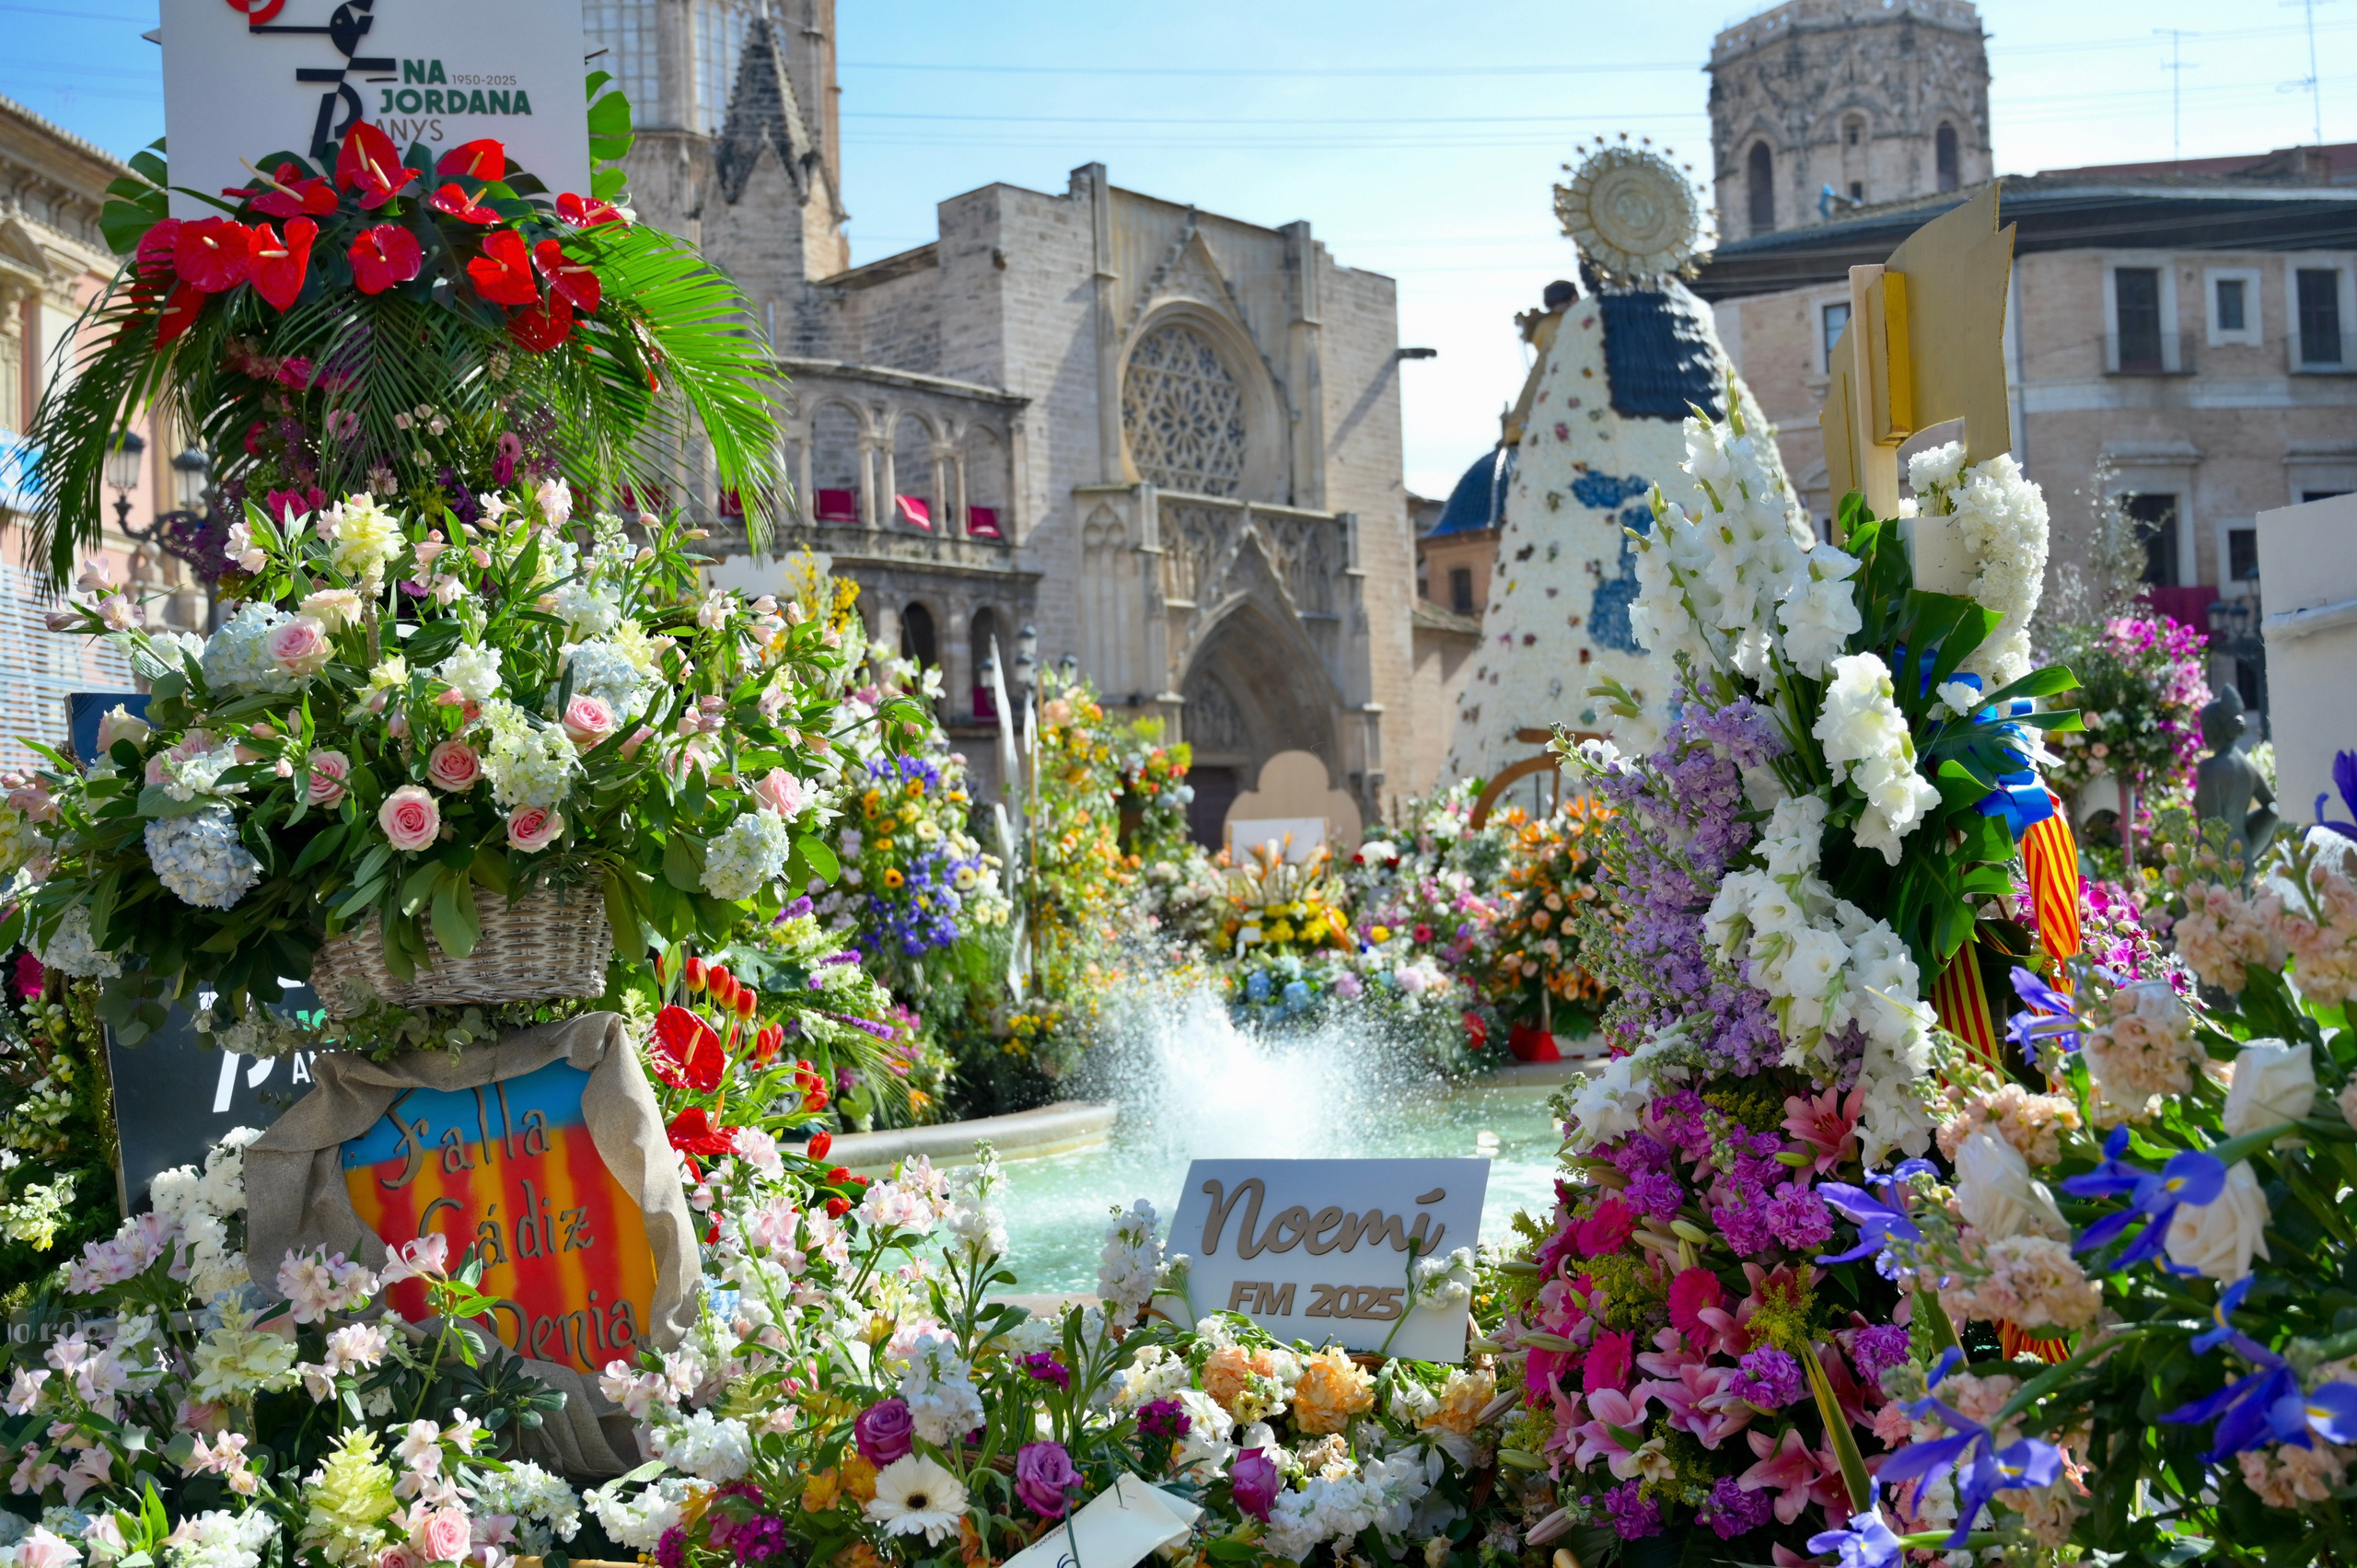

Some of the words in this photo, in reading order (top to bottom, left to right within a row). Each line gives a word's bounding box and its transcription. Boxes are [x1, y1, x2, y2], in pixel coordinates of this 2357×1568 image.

[403, 59, 447, 85] NA
[451, 75, 517, 86] 1950-2025
[380, 88, 532, 116] JORDANA
[1201, 1177, 1446, 1260] Noemí
[1227, 1280, 1296, 1316] FM
[1305, 1283, 1404, 1320] 2025
